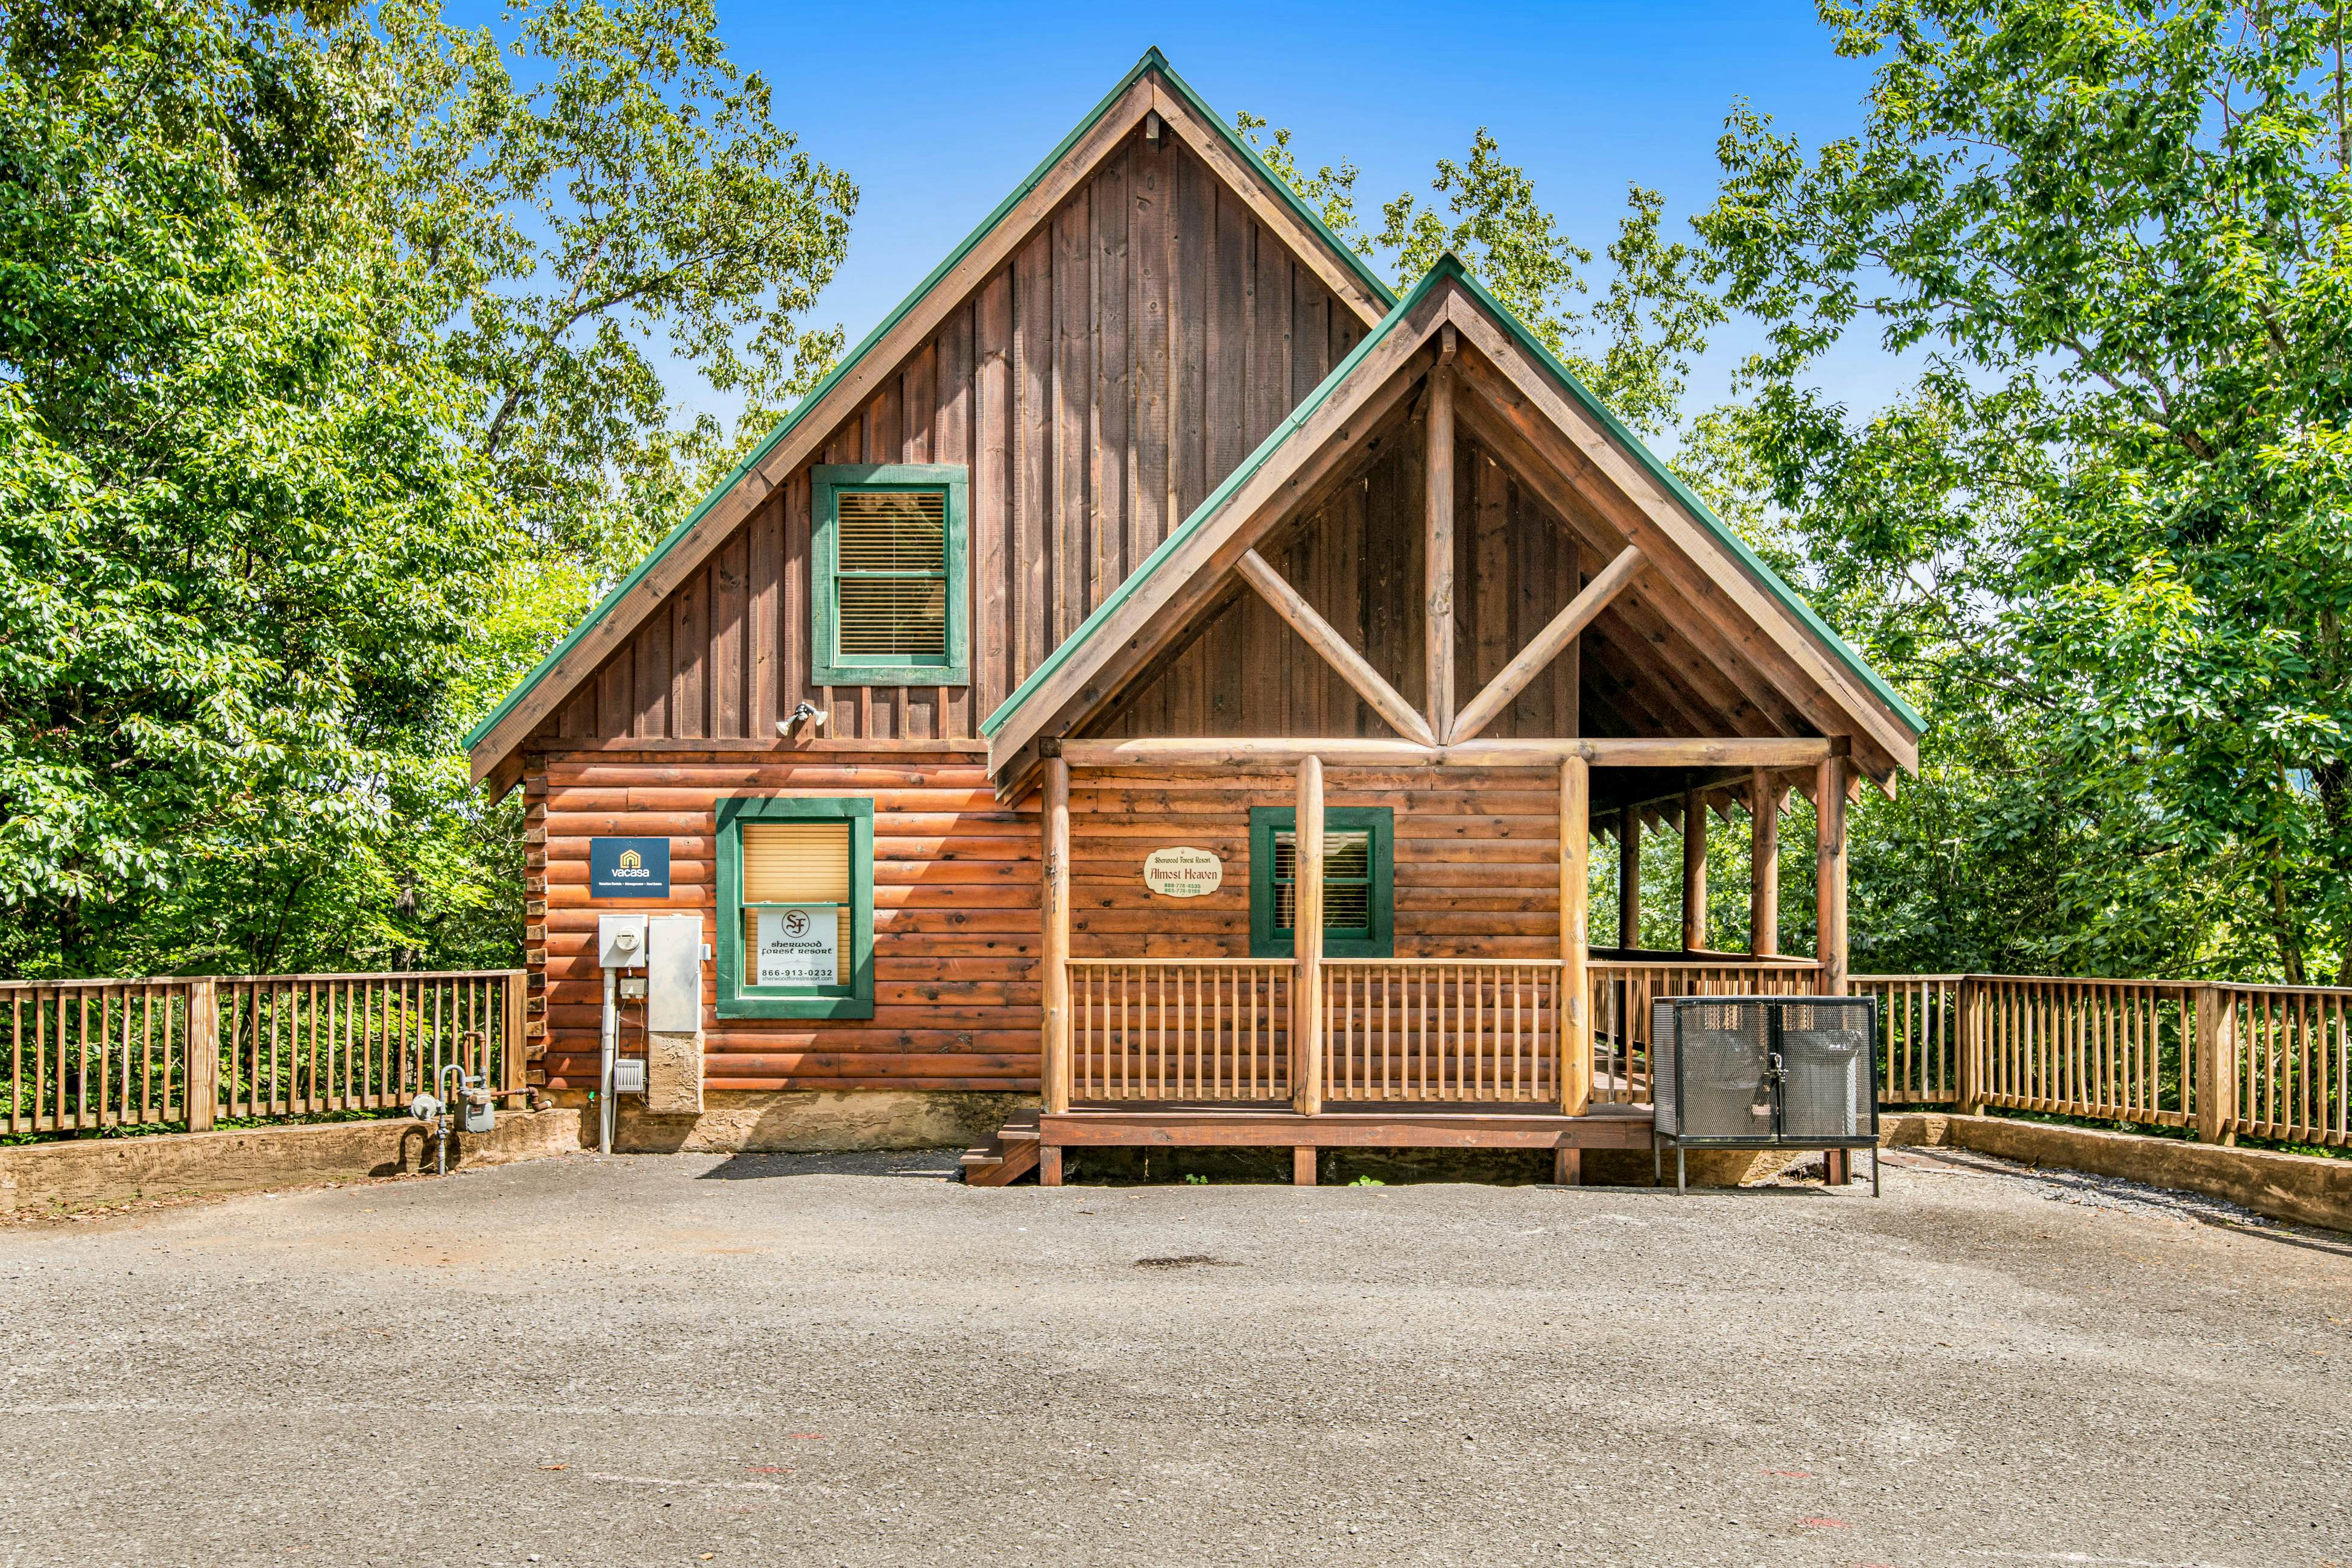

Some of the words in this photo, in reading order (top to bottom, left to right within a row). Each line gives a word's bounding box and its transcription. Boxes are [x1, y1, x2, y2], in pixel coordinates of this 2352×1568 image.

[1150, 868, 1181, 879] Almost
[1185, 868, 1217, 879] Heaven
[786, 914, 806, 934] SF
